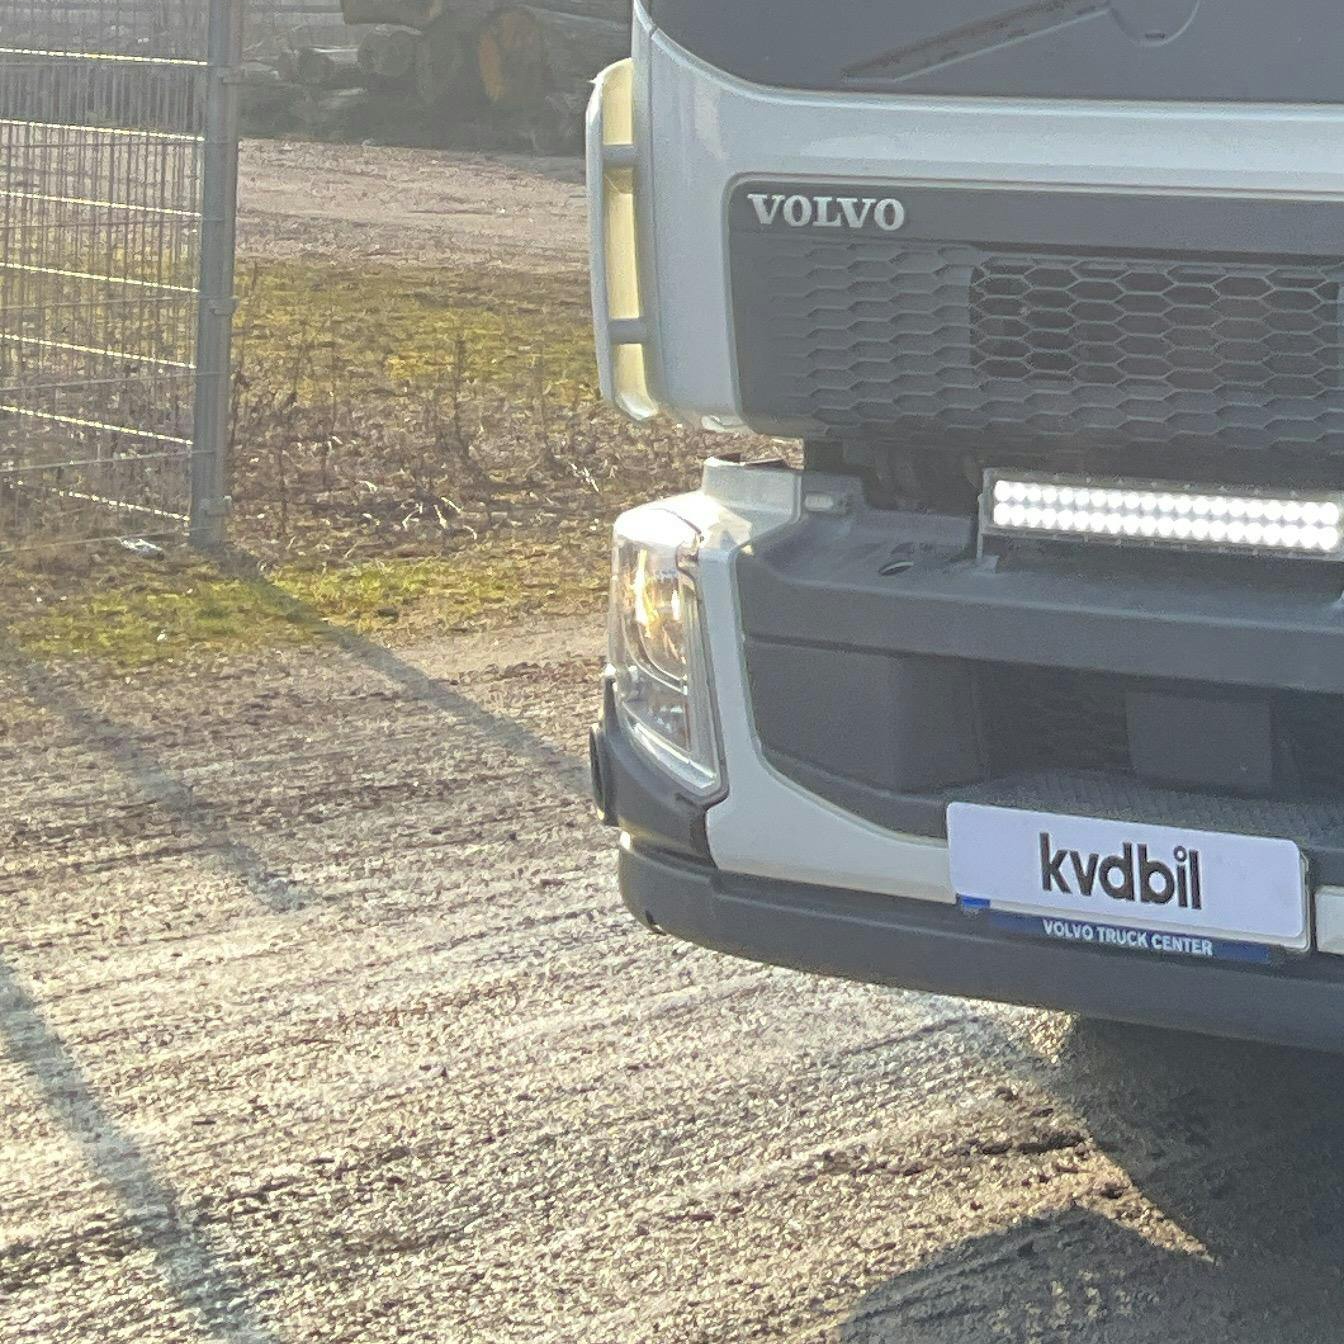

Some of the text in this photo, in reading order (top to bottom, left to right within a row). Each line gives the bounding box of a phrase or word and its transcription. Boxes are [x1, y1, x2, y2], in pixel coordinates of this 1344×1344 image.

[747, 193, 906, 233] VOLVO
[1039, 832, 1203, 910] kvdbil
[1043, 918, 1213, 956] VOLVO TRUCK CENTER
